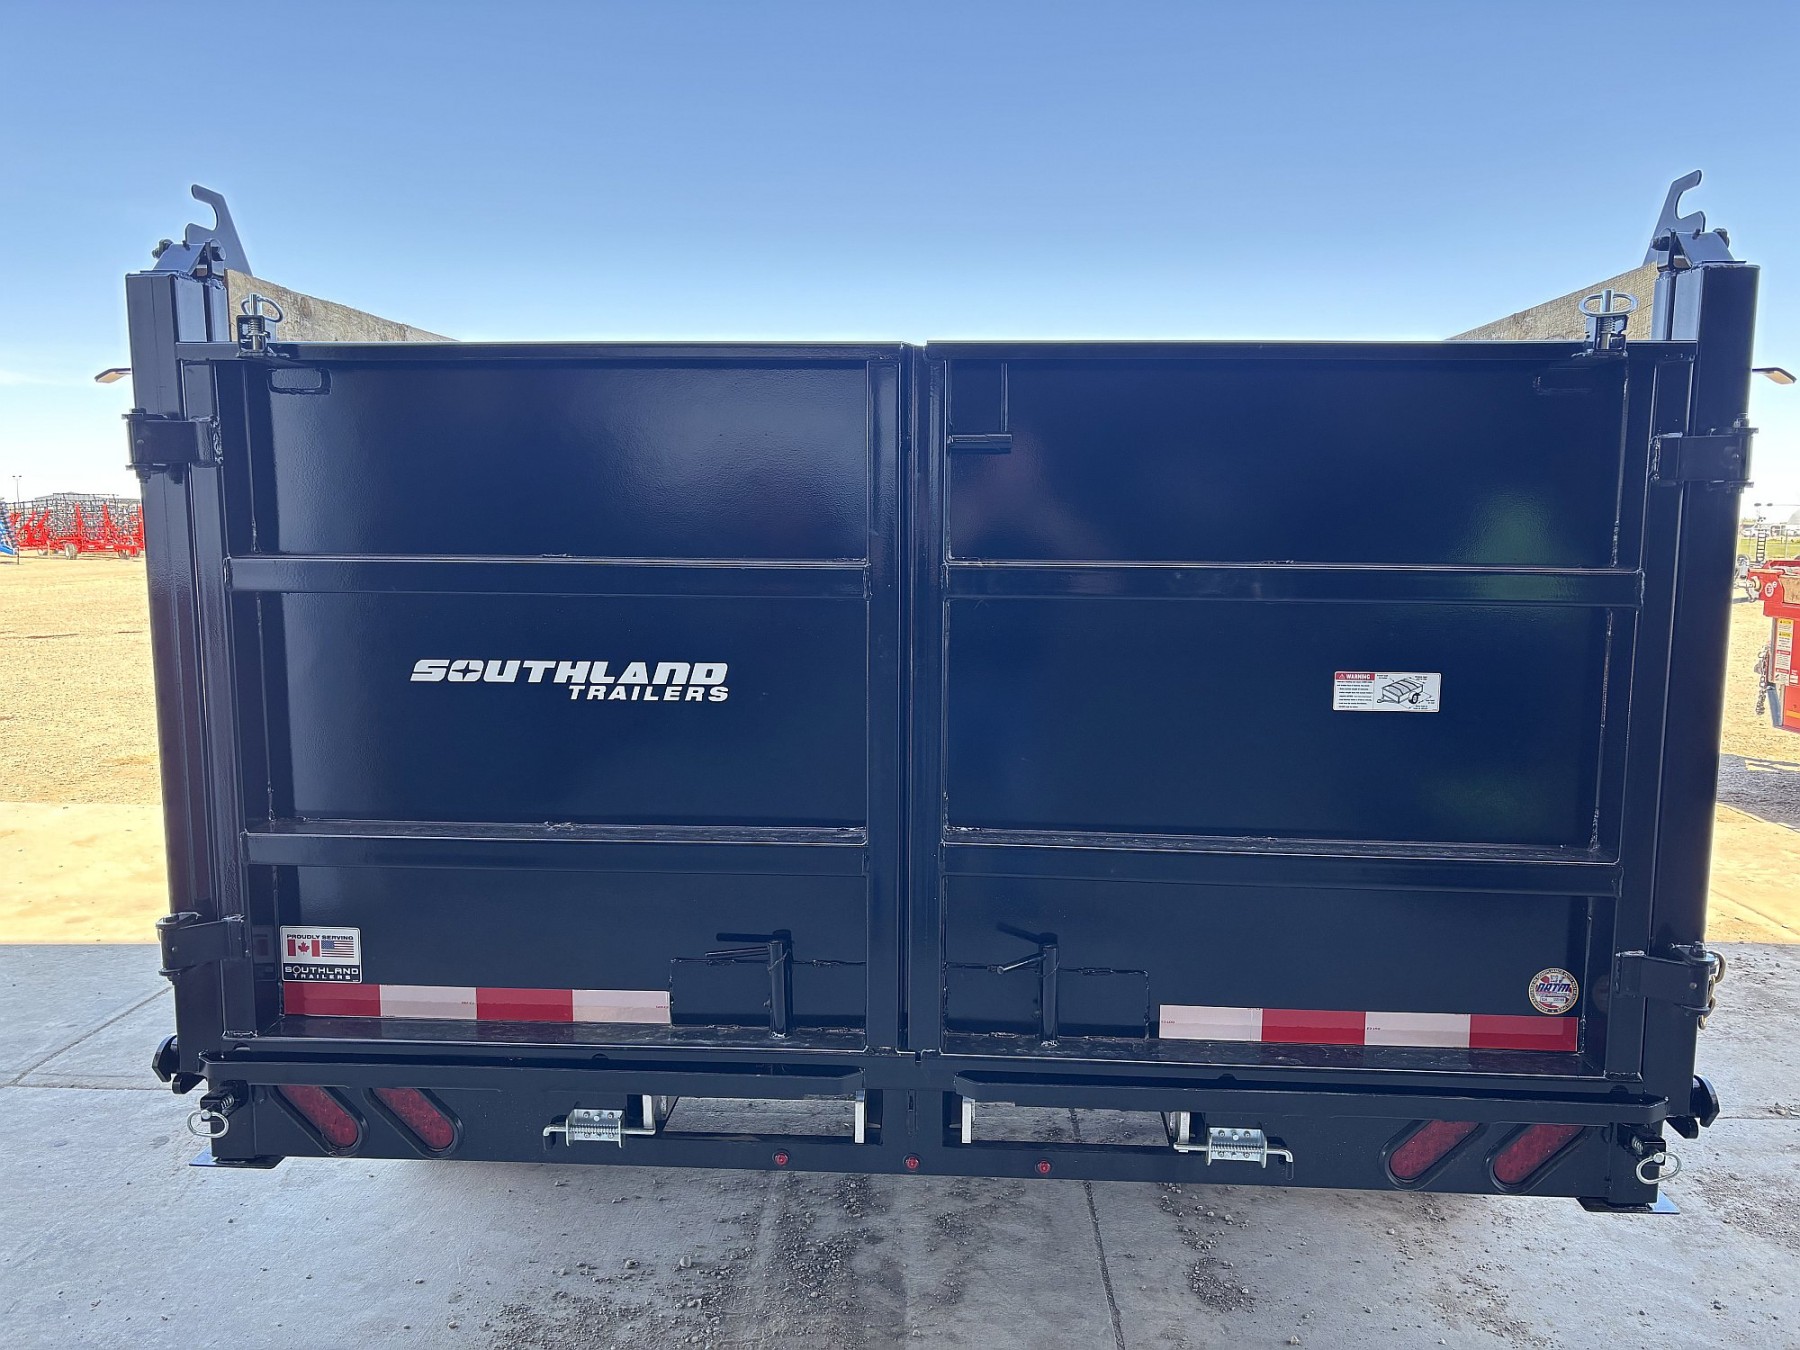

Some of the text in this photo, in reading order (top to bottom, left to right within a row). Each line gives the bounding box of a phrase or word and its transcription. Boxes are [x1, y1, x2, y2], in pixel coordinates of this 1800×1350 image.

[410, 659, 728, 685] SOUTHLAND
[569, 685, 729, 702] TRAILERS
[285, 965, 359, 975] SOUTHLAND
